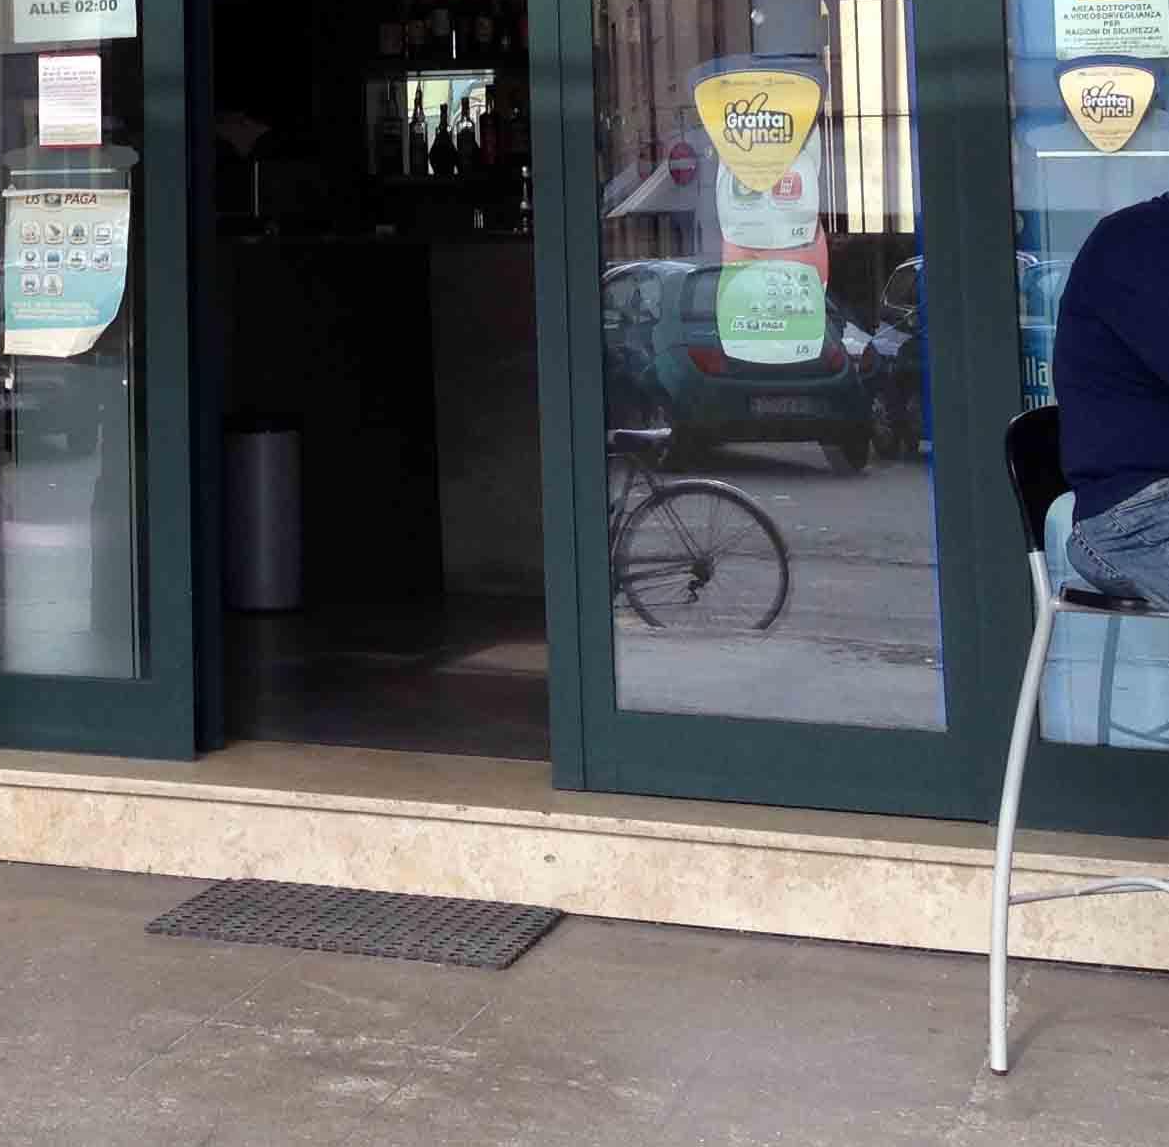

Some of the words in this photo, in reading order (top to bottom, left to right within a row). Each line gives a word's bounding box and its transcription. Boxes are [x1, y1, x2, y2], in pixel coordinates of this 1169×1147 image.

[29, 1, 71, 15] ALLE
[1096, 3, 1152, 11] SOTTOPOSTA
[1083, 95, 1127, 108] Gratta
[727, 112, 784, 129] Gratta
